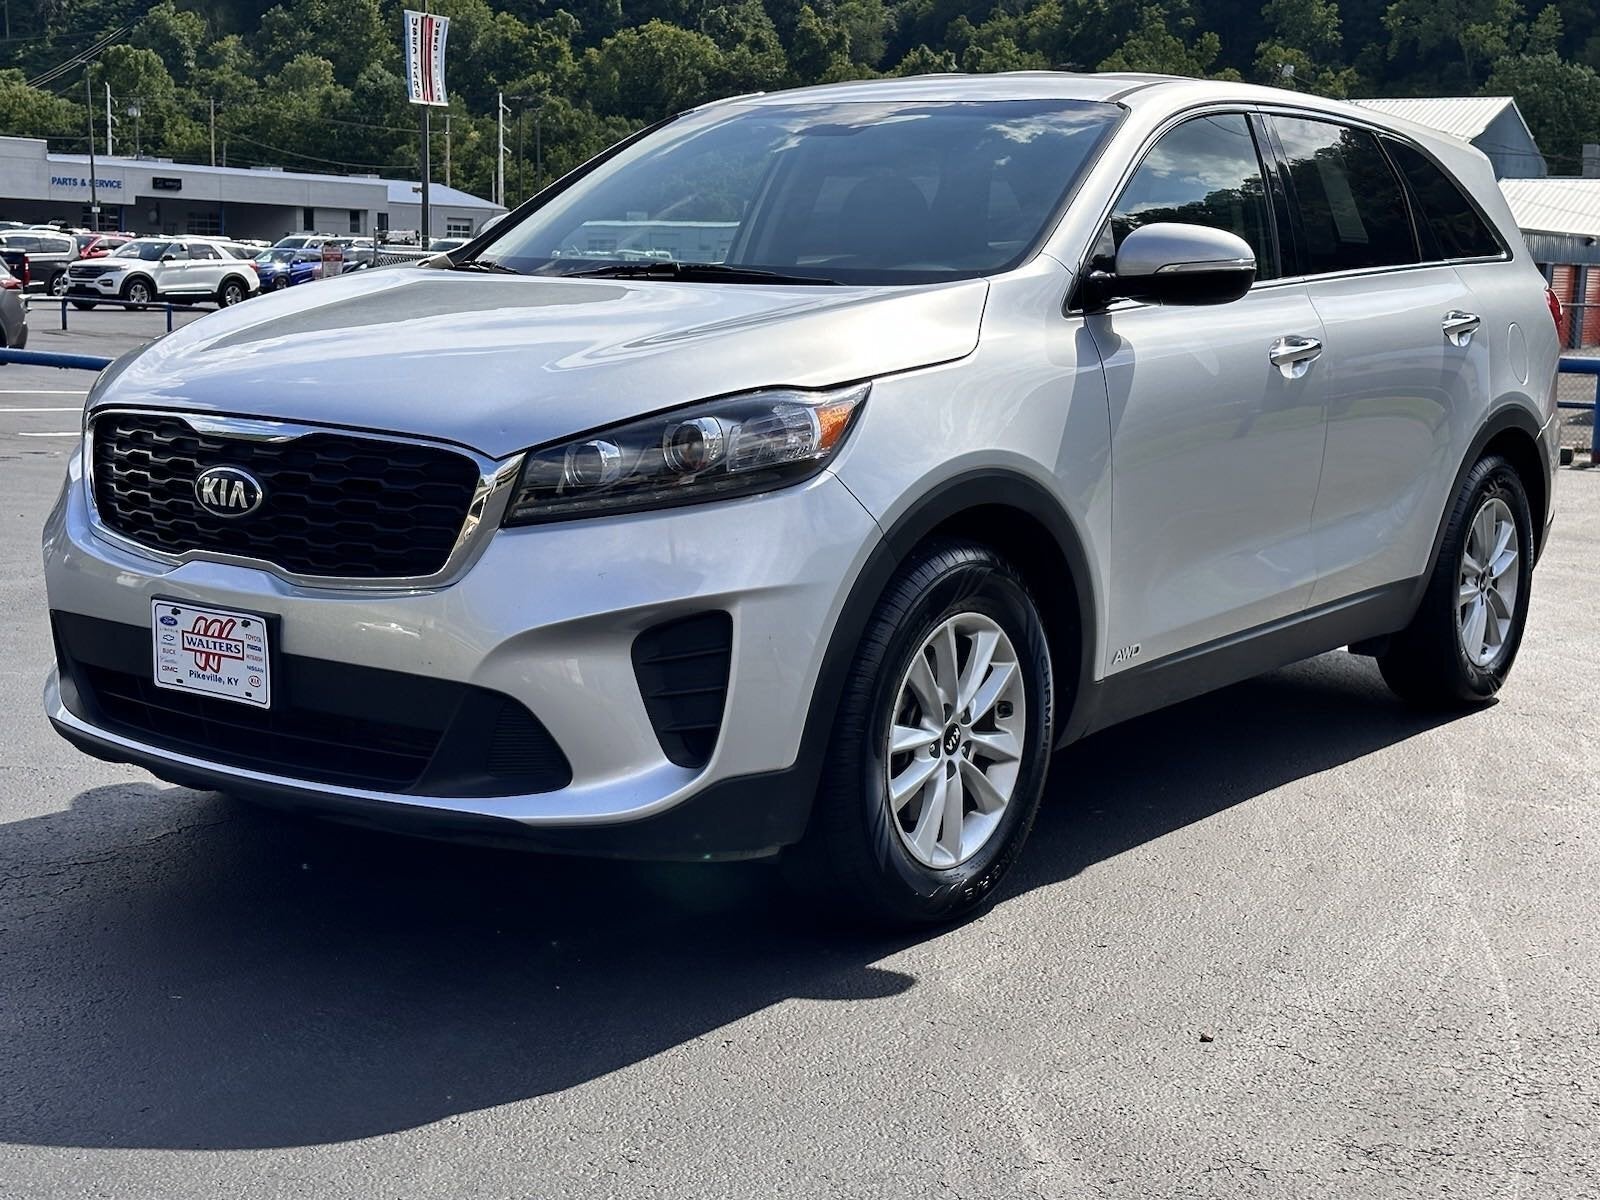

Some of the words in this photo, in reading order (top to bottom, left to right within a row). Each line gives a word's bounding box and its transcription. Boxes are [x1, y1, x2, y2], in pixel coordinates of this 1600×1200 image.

[433, 21, 441, 52] USED
[412, 61, 421, 98] CARS
[51, 176, 78, 187] PARTS
[80, 179, 87, 187] &
[203, 476, 248, 508] KIA
[185, 635, 241, 655] WALTERS
[1111, 643, 1141, 665] AWD
[161, 665, 179, 673] GMC
[189, 669, 226, 685] Pikeville,
[227, 676, 239, 686] KY
[945, 727, 961, 751] KIA
